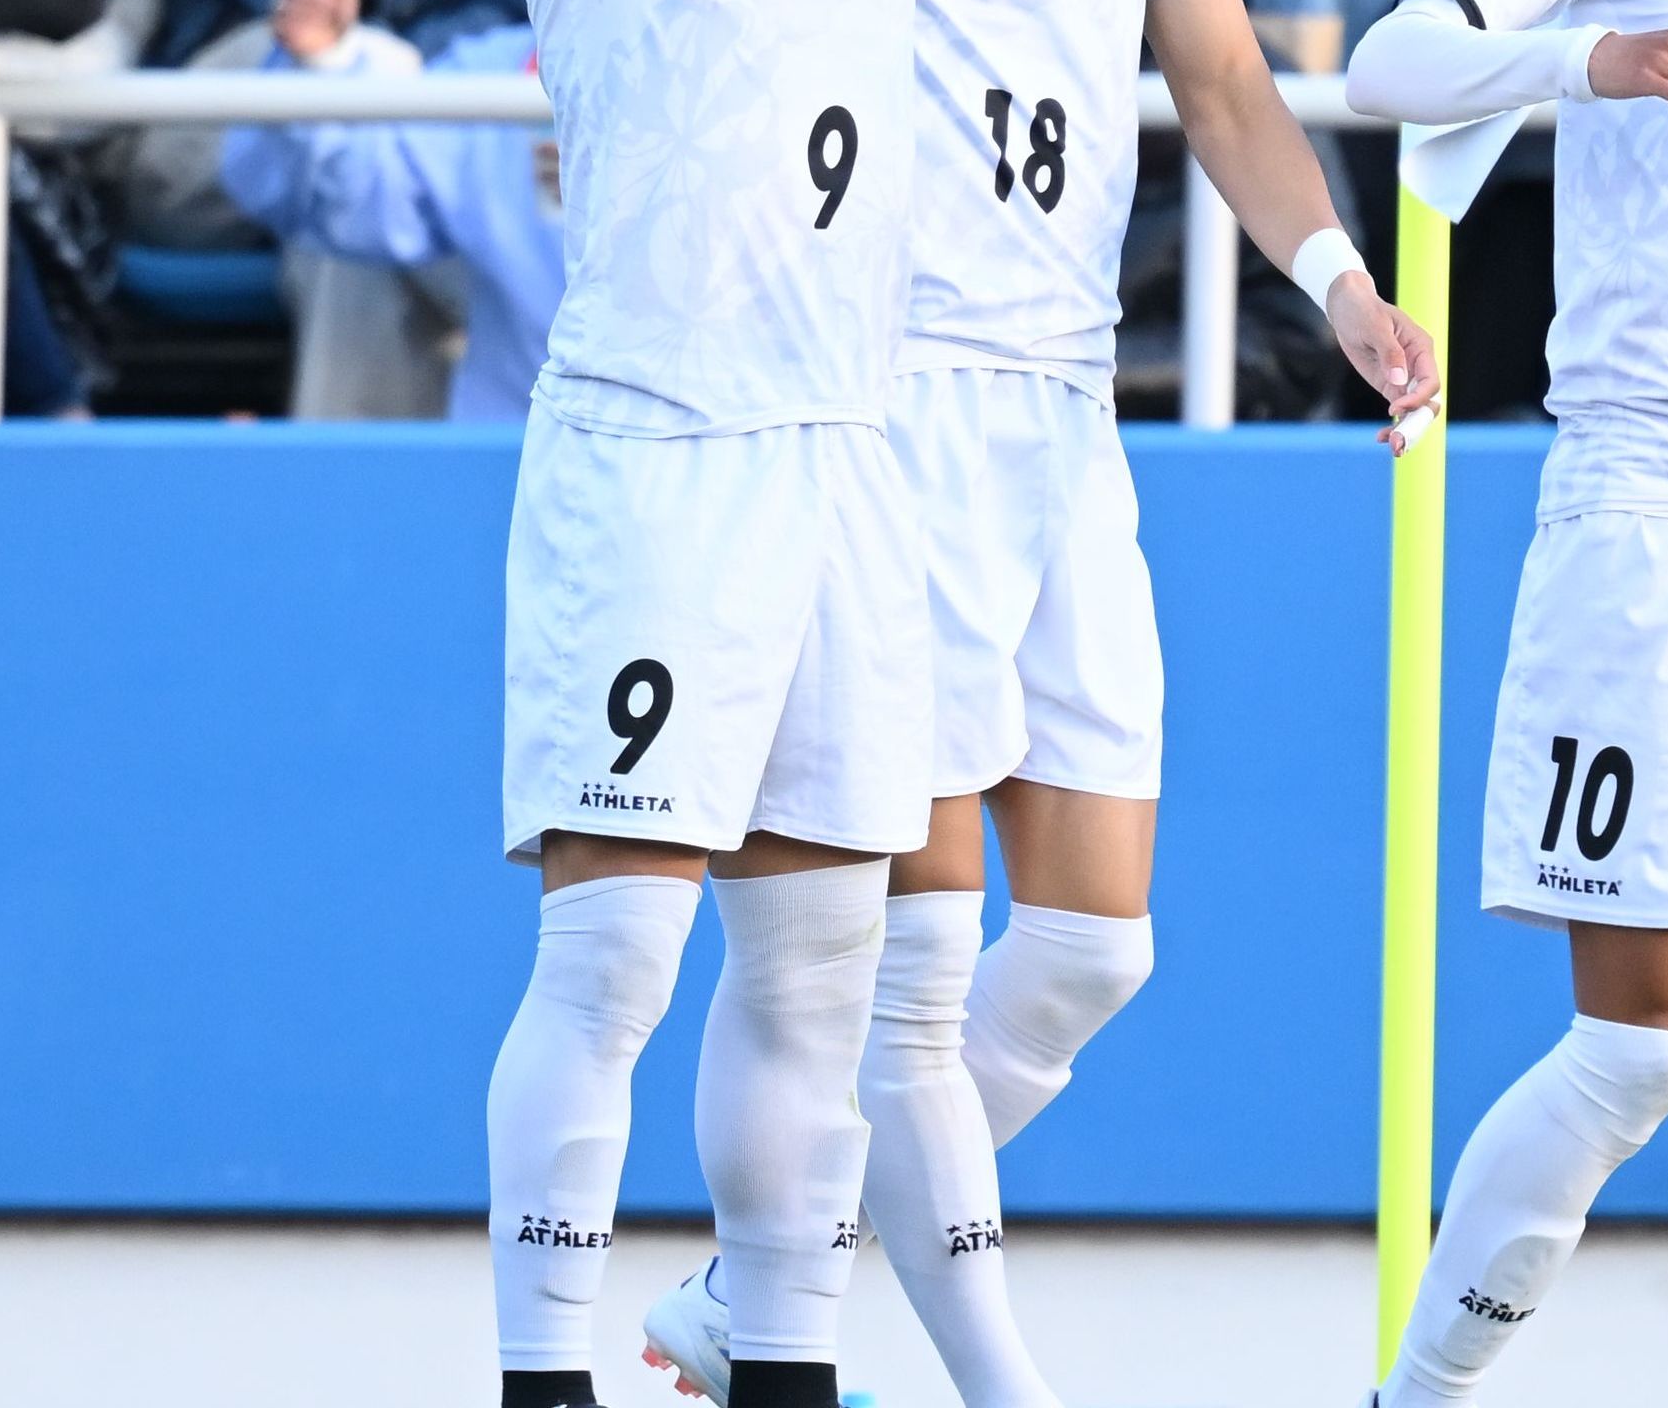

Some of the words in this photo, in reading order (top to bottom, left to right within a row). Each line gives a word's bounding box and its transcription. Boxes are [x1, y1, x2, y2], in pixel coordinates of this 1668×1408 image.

[807, 105, 859, 230] 9
[985, 88, 1067, 215] 18
[607, 658, 674, 776] 9
[579, 791, 673, 814] ATHLETA
[1540, 735, 1635, 862] 10
[1537, 872, 1621, 897] ATHLETA
[517, 1225, 613, 1249] ATHLET
